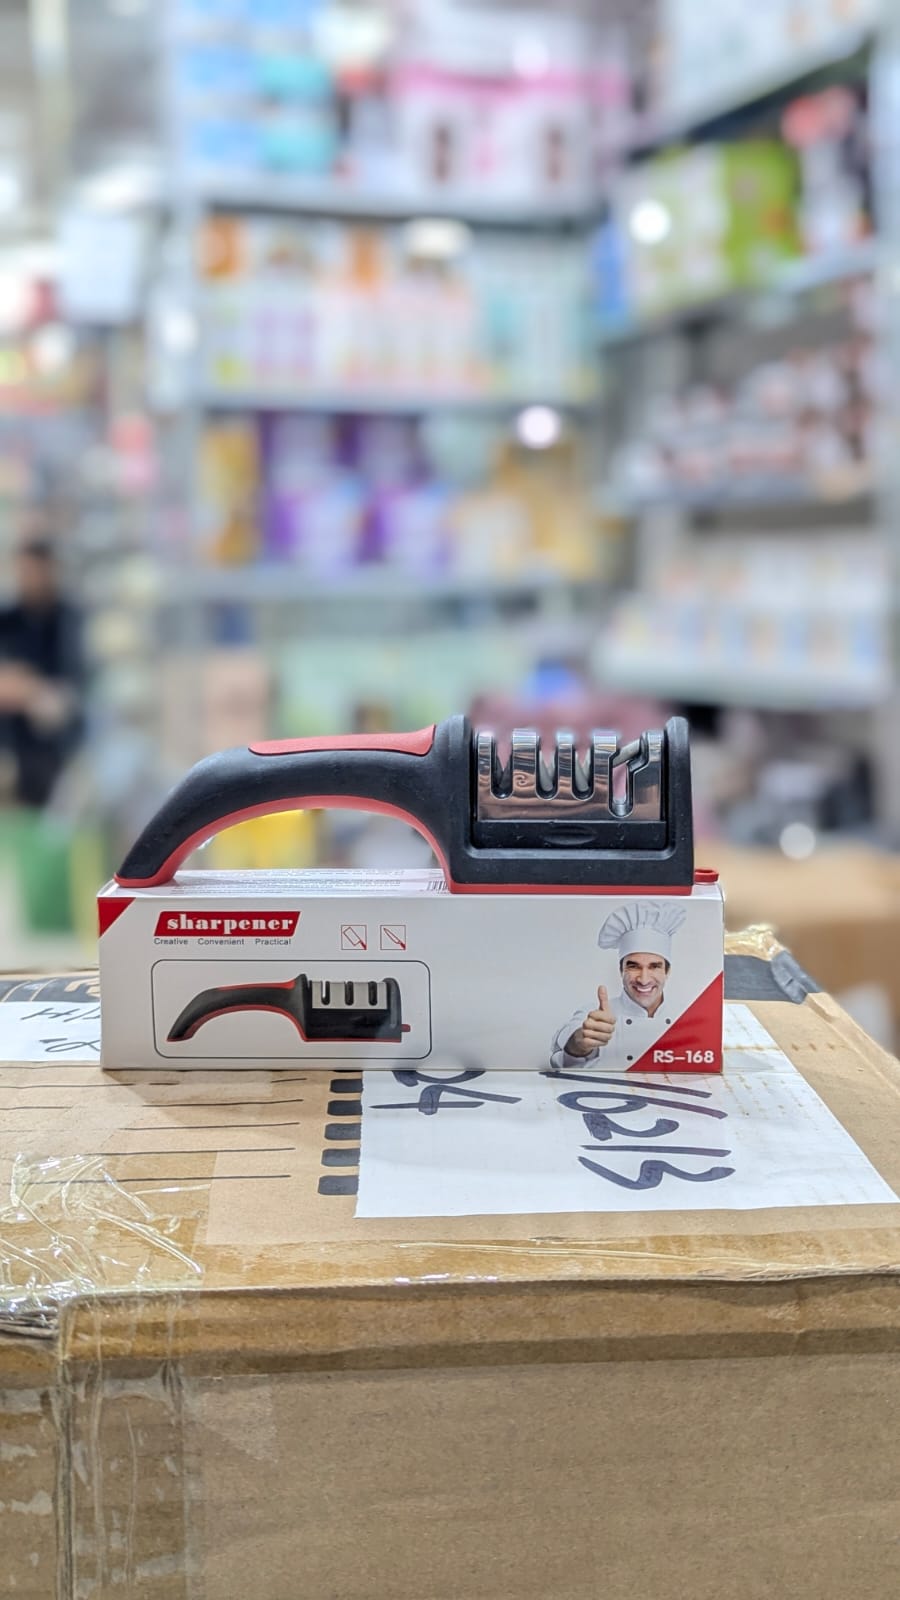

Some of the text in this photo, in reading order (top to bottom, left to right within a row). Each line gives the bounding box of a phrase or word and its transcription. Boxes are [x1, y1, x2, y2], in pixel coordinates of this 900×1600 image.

[167, 913, 294, 935] sharpener
[153, 938, 292, 946] Creative Convenient Practical
[653, 1050, 715, 1064] RS-168
